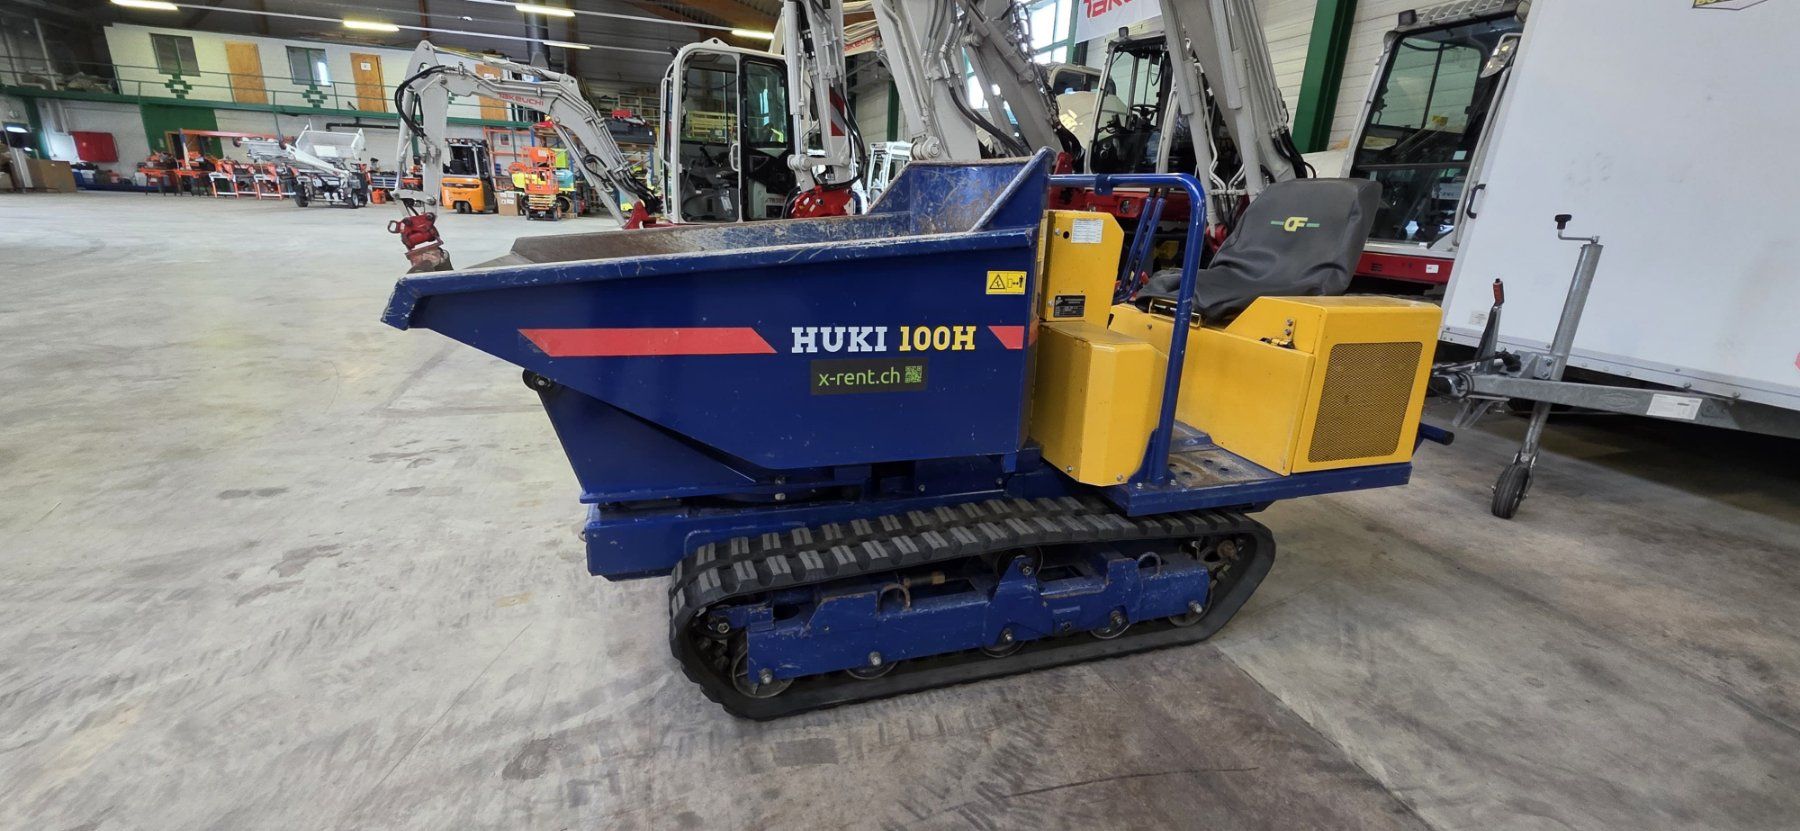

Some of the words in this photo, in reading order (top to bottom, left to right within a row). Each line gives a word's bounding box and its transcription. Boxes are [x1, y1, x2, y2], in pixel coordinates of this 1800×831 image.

[792, 326, 888, 353] HUKI
[899, 326, 977, 352] 100H
[818, 367, 900, 386] x-rent.ch
